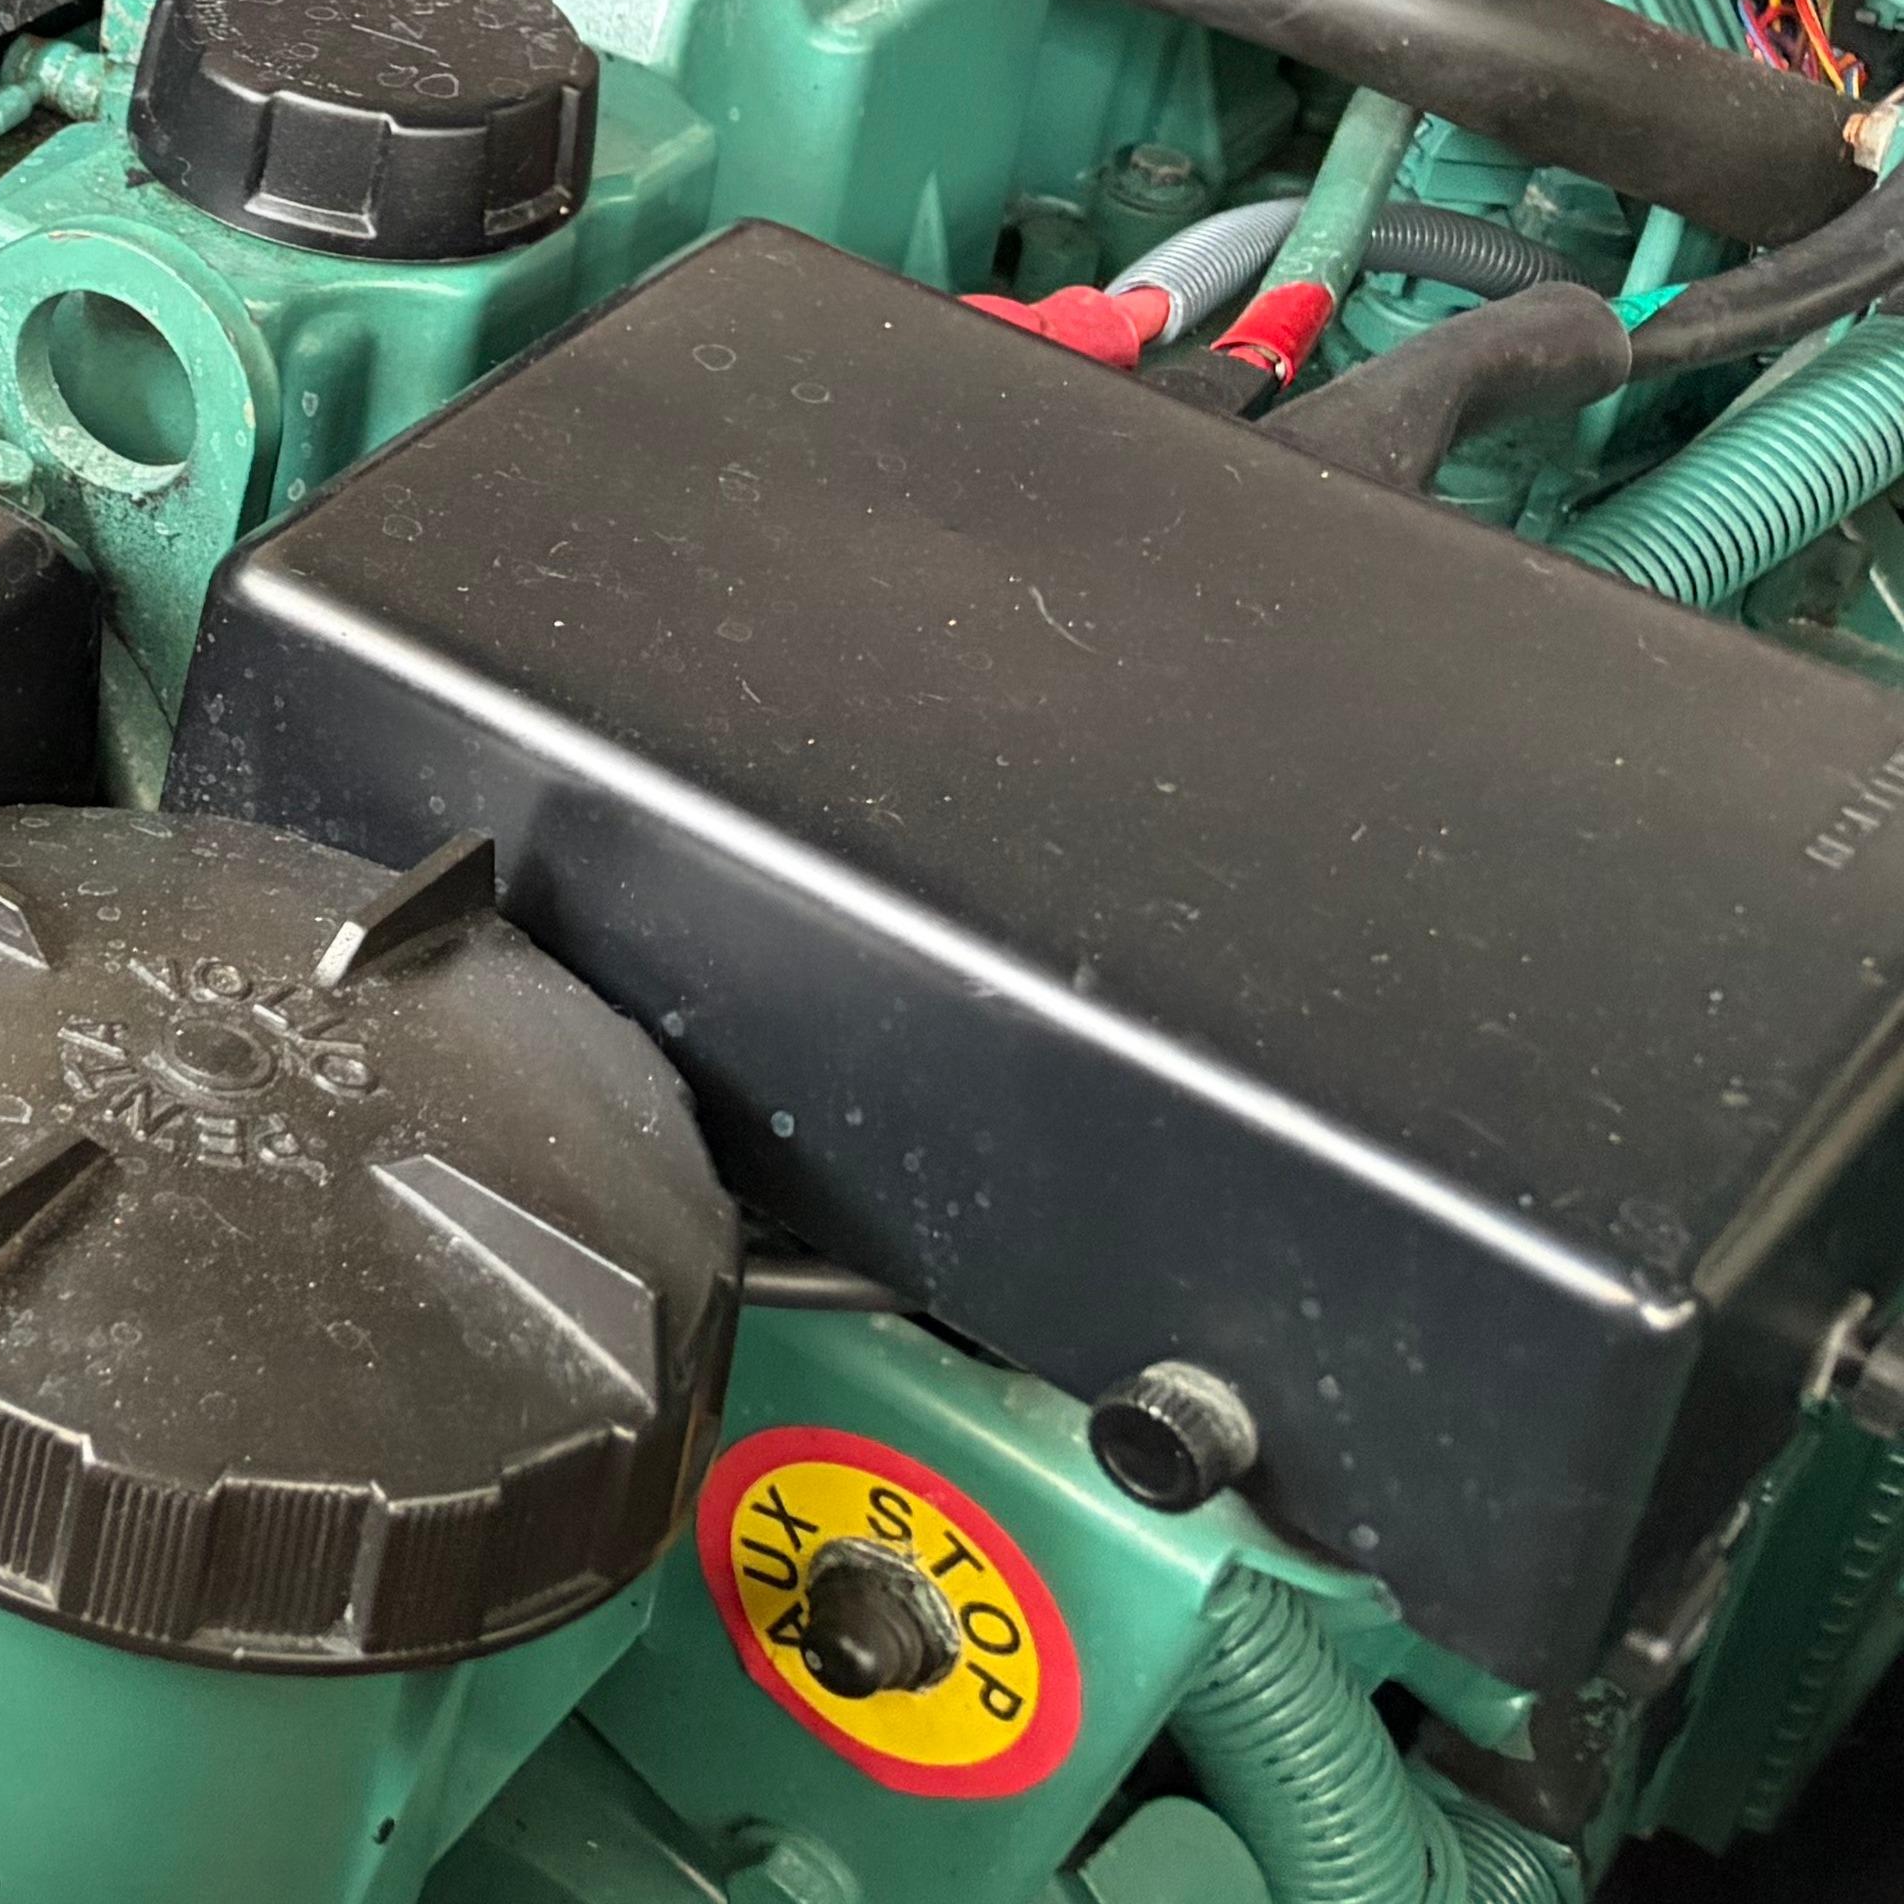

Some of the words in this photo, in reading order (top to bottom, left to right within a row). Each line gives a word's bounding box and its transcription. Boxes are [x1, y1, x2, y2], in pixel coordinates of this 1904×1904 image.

[128, 956, 381, 1098] VOLVO
[740, 1485, 819, 1651] AUX
[867, 1487, 1023, 1723] STOP
